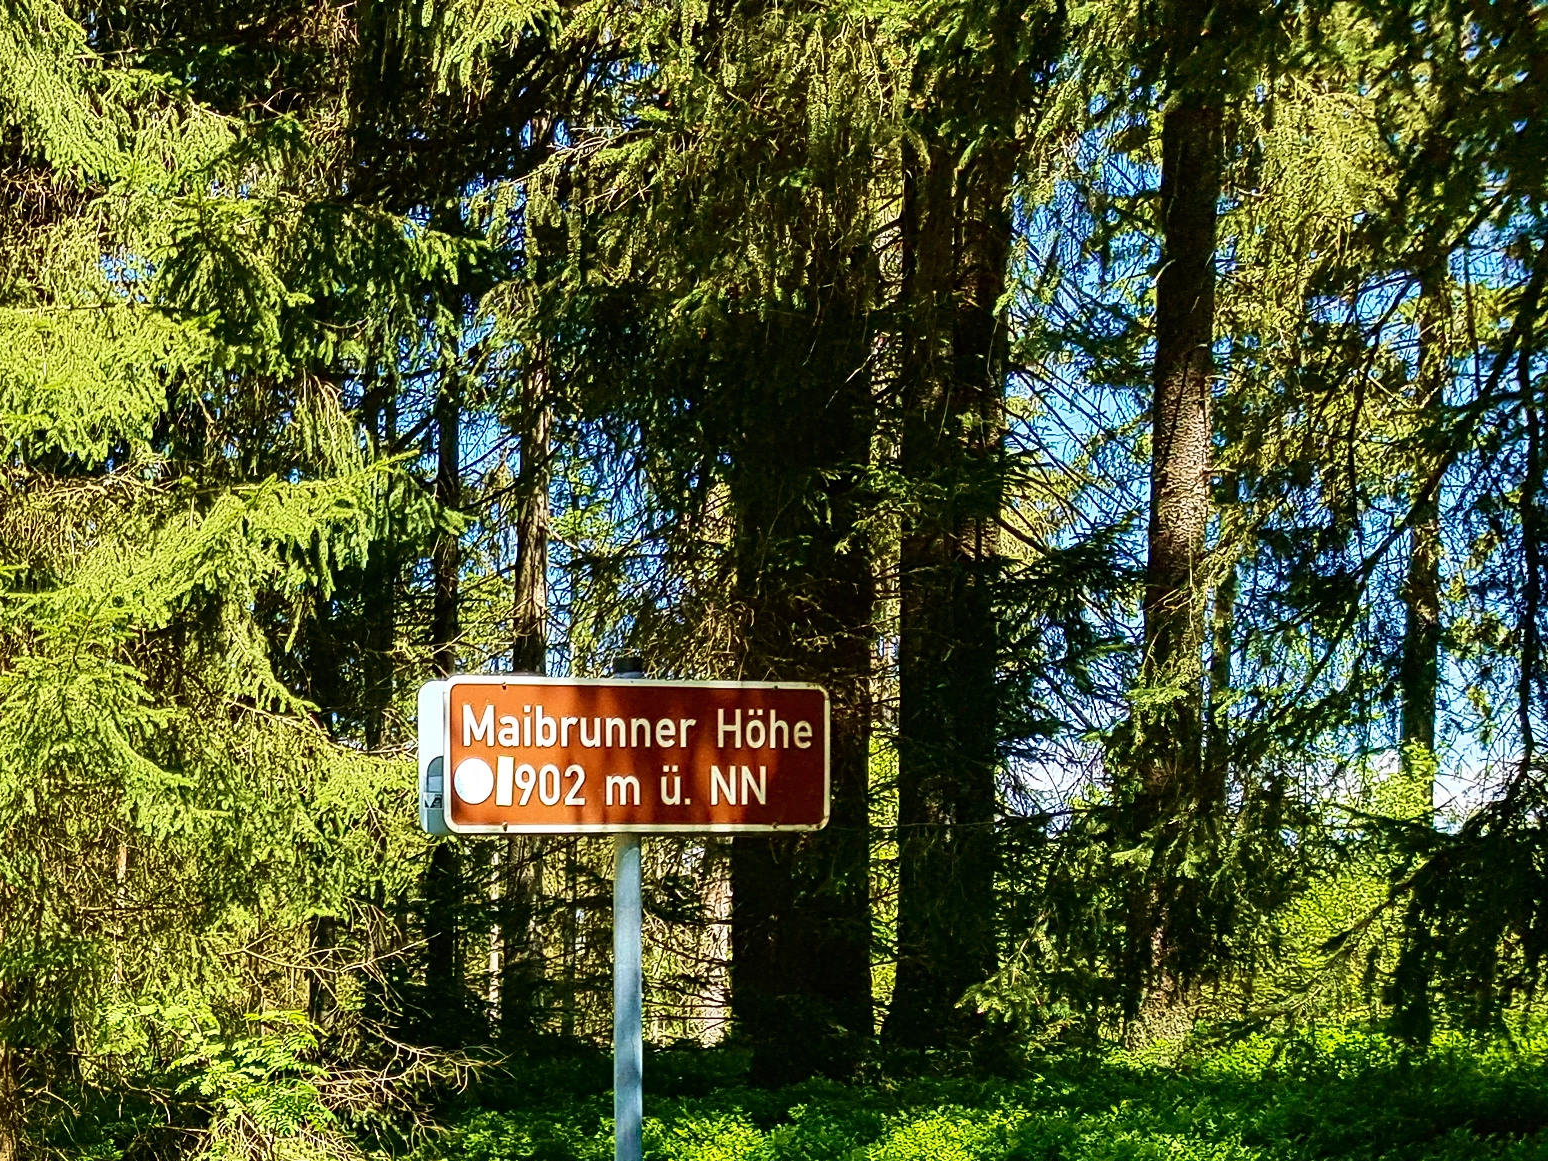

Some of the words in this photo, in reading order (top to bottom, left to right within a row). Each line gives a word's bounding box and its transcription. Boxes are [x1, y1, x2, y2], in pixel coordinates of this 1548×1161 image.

[462, 704, 696, 748] Maibrunner
[717, 708, 813, 749] Höhe
[514, 763, 586, 806] 902
[605, 774, 640, 806] m
[660, 765, 691, 806] ü.
[710, 765, 767, 806] NN
